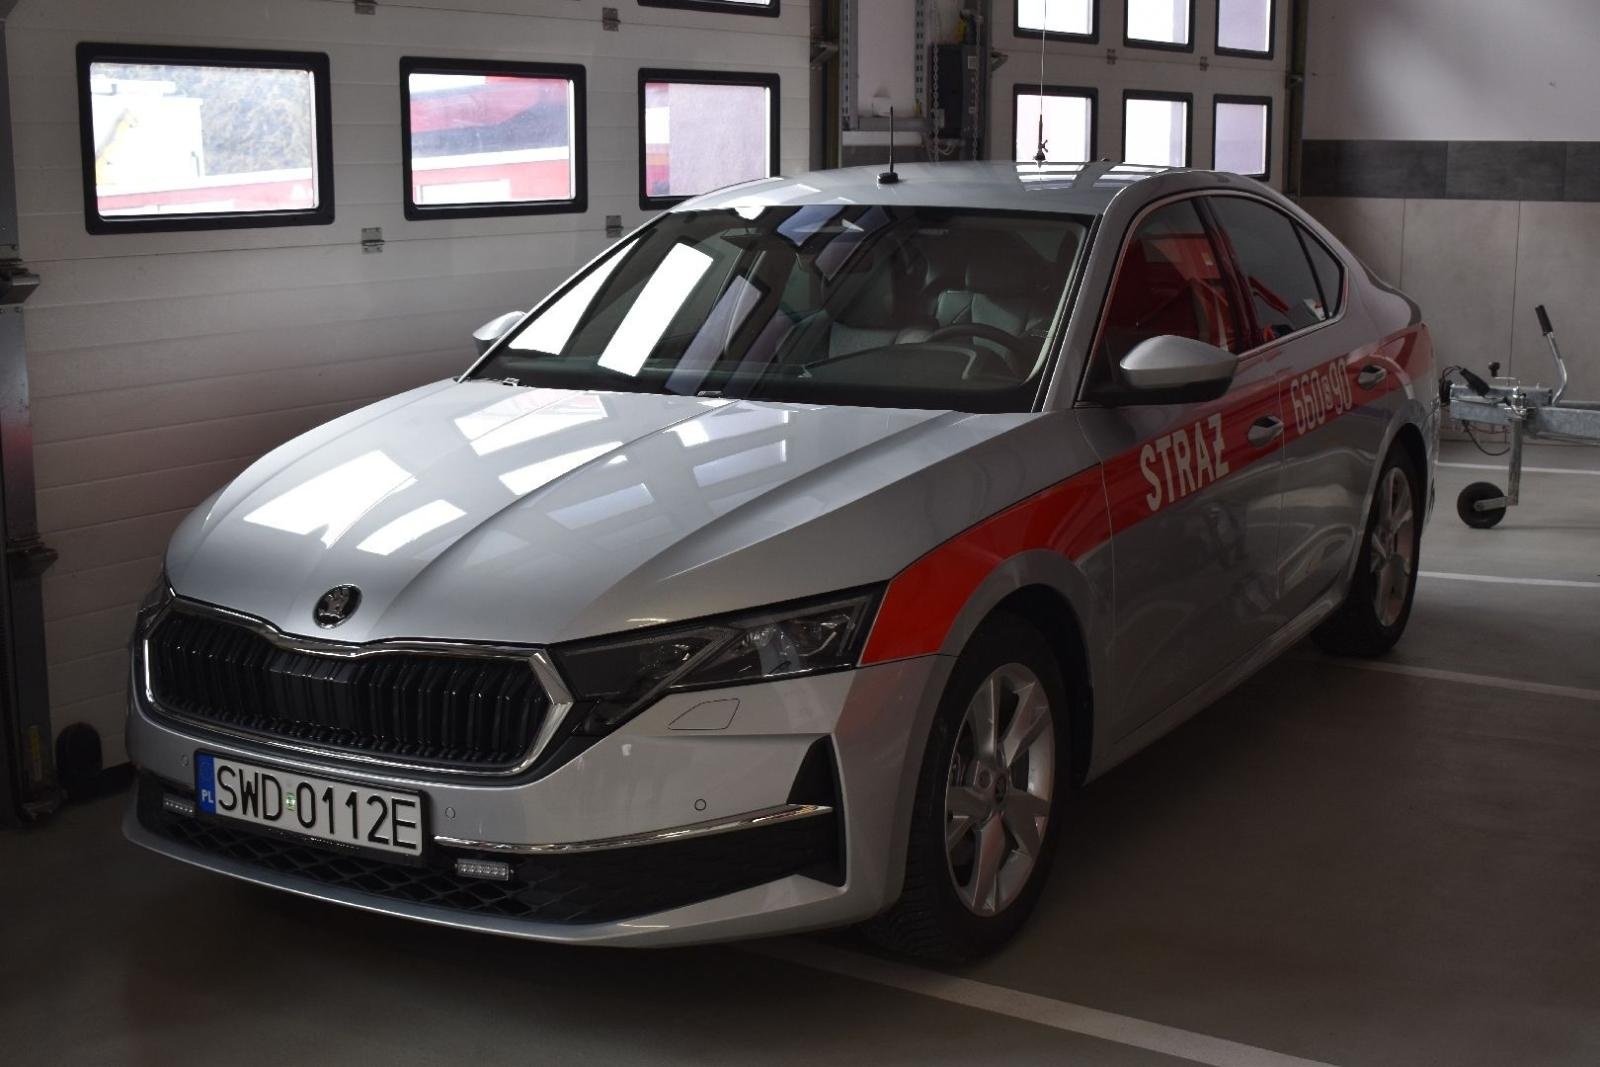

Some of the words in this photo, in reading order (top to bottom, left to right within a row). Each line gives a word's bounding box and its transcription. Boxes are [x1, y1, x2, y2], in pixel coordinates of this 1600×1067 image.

[201, 789, 214, 803] PL
[217, 765, 282, 821] SWD
[296, 782, 417, 849] 0112E
